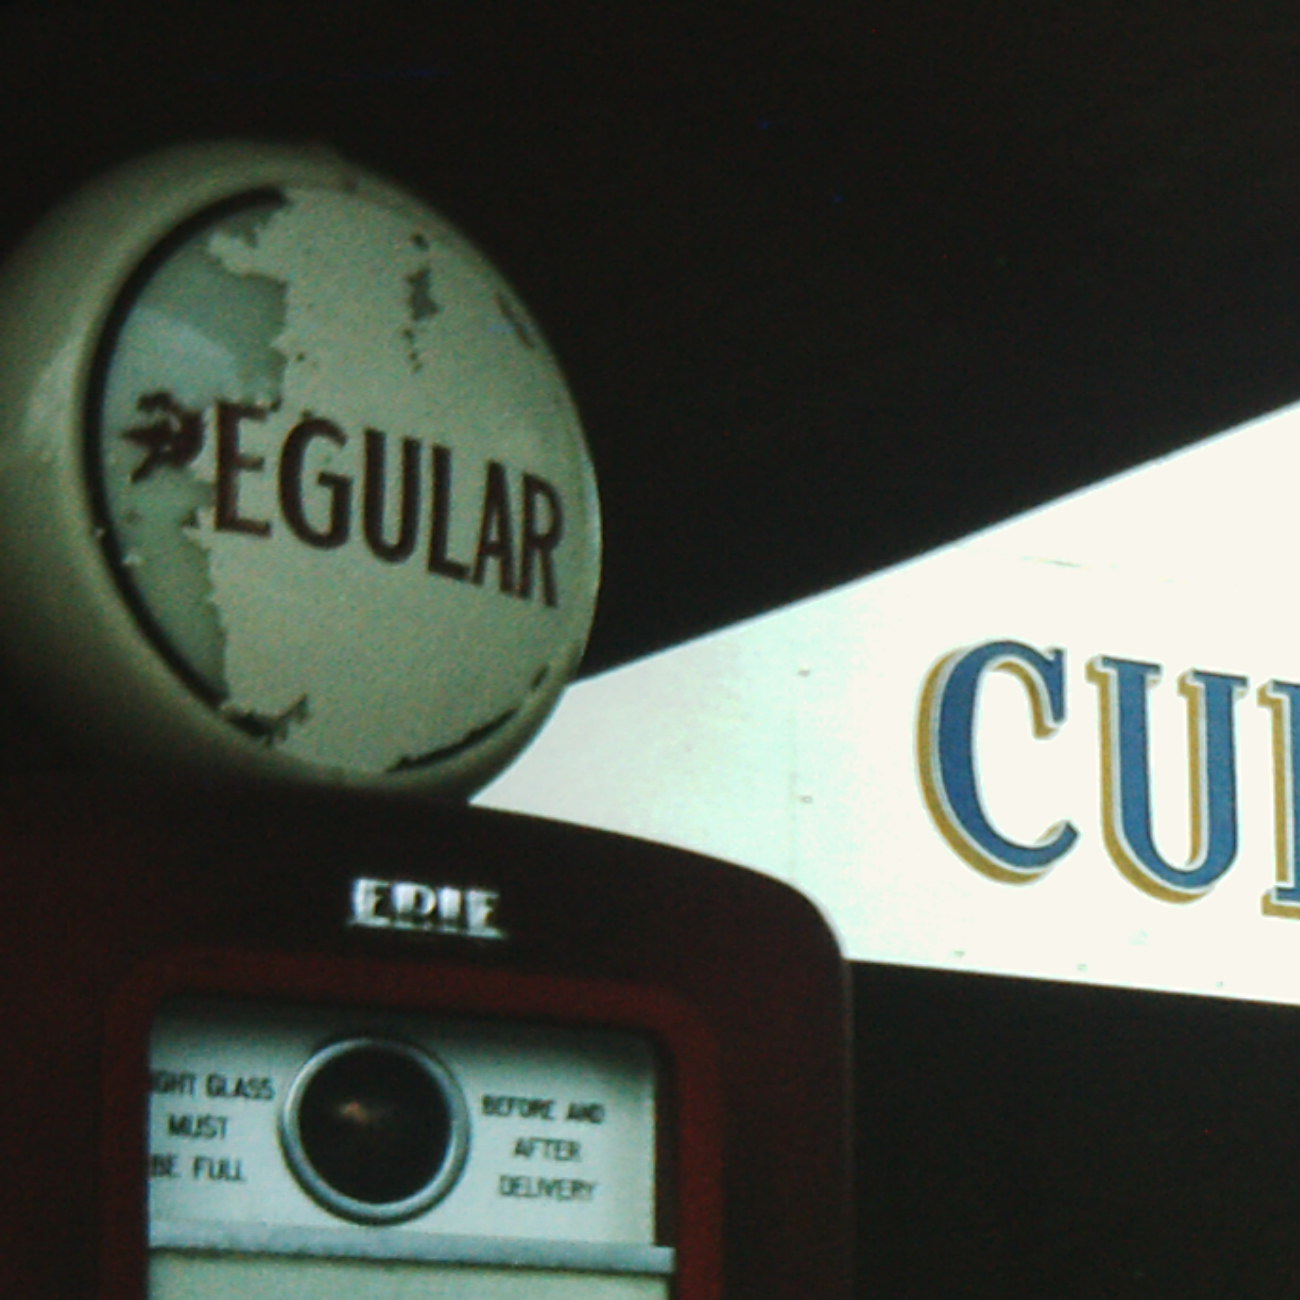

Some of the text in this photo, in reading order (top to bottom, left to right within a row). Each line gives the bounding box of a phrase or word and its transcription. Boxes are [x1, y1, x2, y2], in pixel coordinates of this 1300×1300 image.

[205, 1073, 276, 1100] GLASS
[481, 1094, 606, 1124] BEFORE AND
[167, 1114, 228, 1139] MUST
[513, 1137, 582, 1162] AFTER
[193, 1155, 248, 1182] FULL
[498, 1174, 599, 1201] DELIVERY
